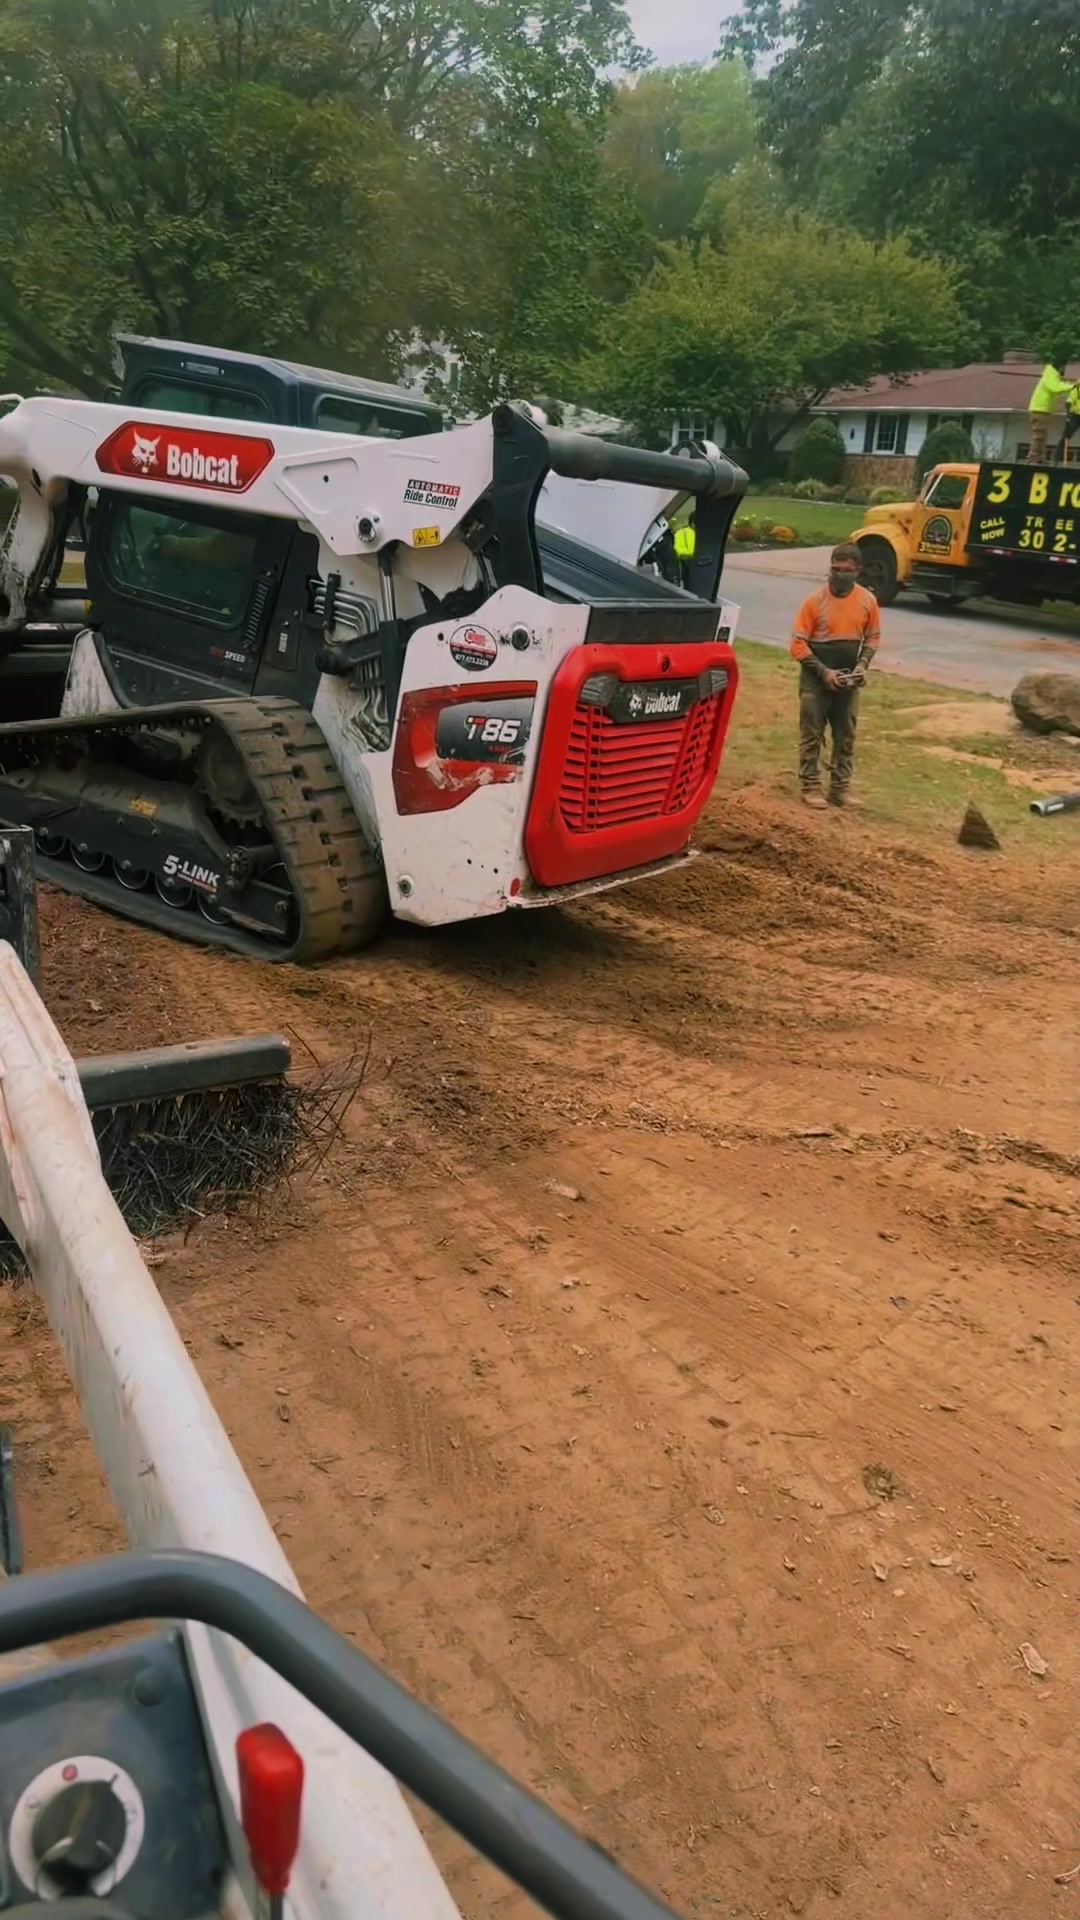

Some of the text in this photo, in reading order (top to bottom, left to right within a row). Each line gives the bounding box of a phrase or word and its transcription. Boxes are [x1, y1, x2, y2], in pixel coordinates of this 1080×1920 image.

[166, 443, 239, 486] Bobcat
[408, 480, 460, 496] AUTOMATIC
[987, 470, 1012, 503] 3
[404, 489, 458, 508] Ride Control
[980, 516, 1005, 529] CALL
[981, 528, 1005, 541] NOW
[224, 650, 246, 663] SPEED
[466, 716, 522, 743] T86
